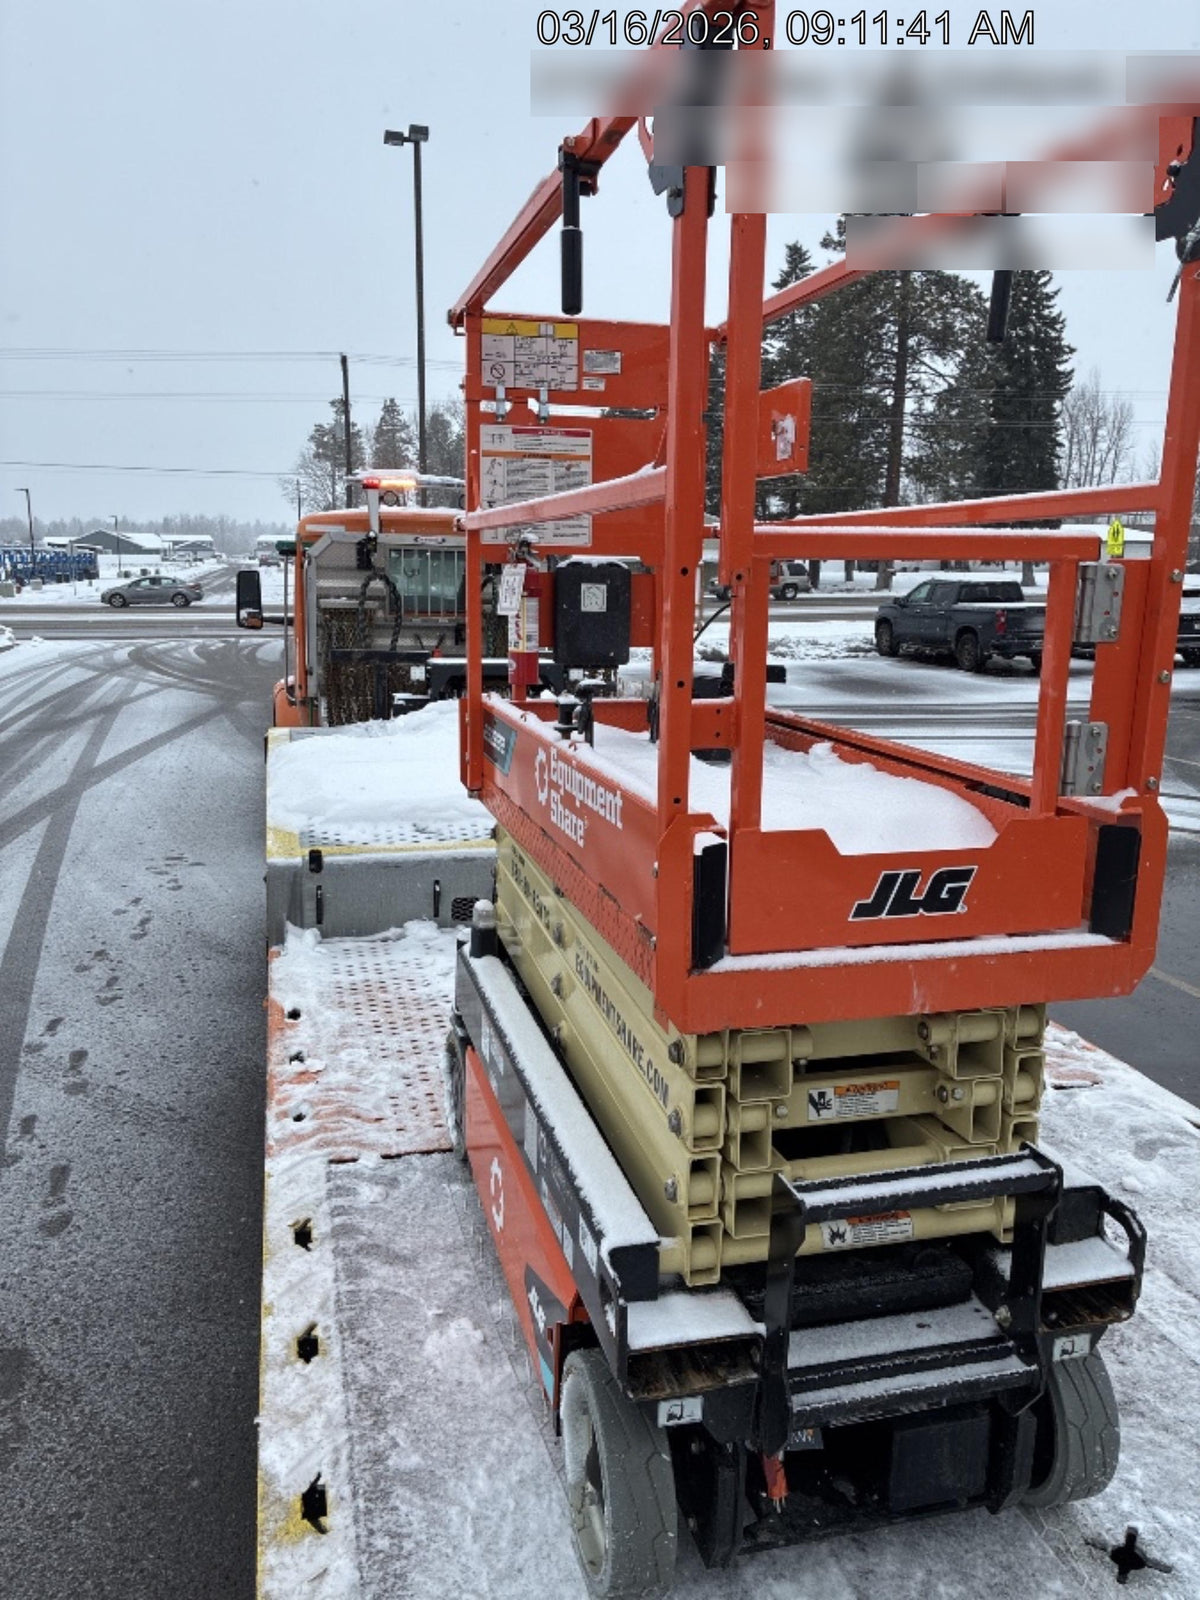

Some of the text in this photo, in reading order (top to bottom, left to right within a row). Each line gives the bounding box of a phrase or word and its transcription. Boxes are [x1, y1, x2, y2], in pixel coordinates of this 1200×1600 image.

[550, 746, 623, 830] Equipment
[550, 788, 585, 849] Share
[847, 864, 979, 922] JLG
